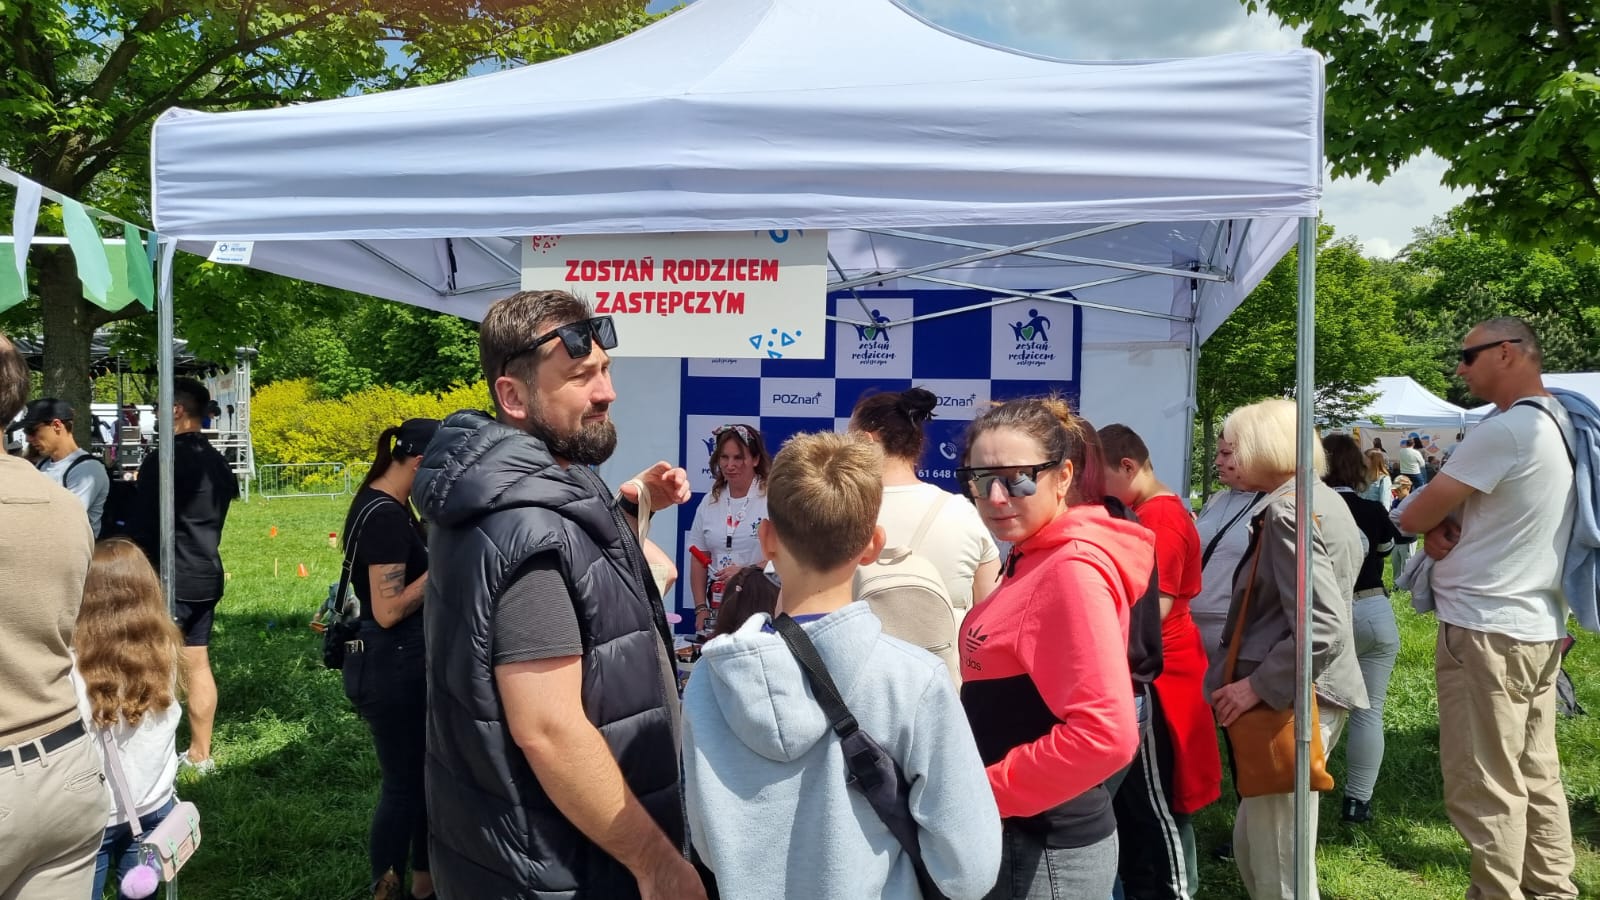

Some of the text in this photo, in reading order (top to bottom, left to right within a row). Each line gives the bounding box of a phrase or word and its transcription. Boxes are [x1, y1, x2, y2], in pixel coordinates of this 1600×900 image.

[565, 256, 779, 284] ZOSTAŃ RODZICEM
[595, 290, 745, 316] ZASTĘPCZYM
[918, 469, 930, 478] 61
[932, 469, 951, 478] 648
